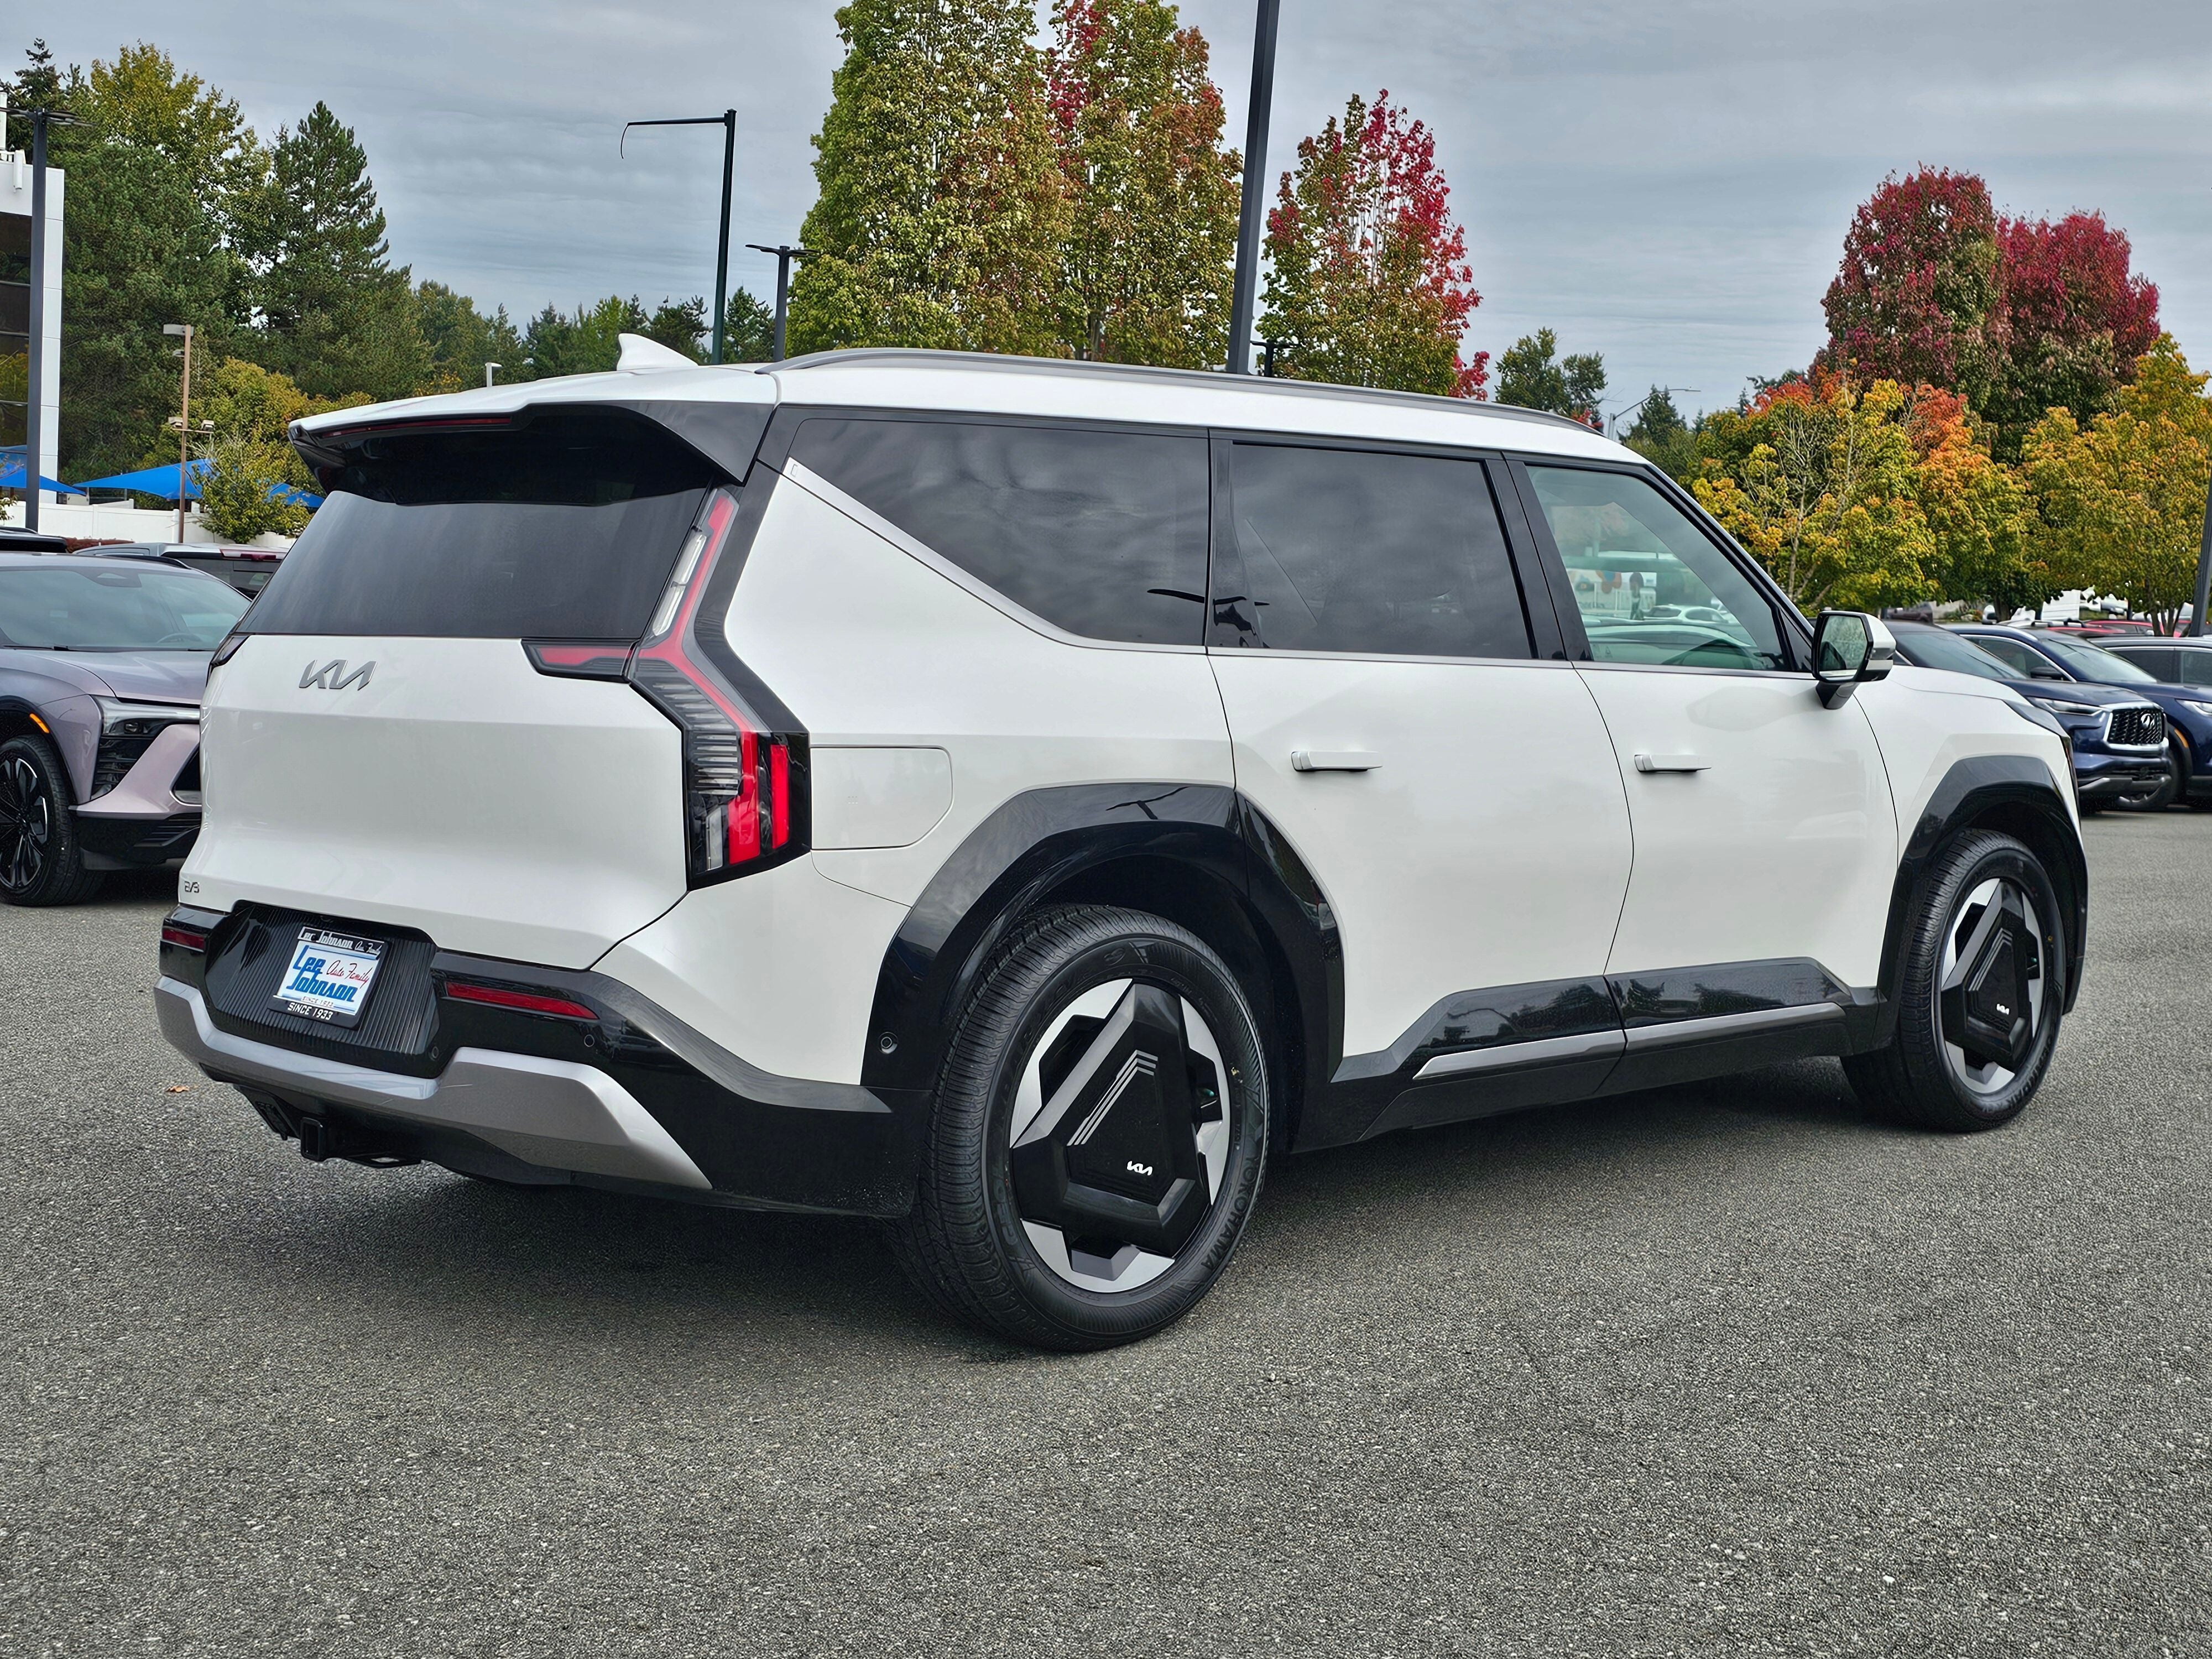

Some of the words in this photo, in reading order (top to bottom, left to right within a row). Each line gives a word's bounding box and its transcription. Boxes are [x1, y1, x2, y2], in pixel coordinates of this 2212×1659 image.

[299, 659, 377, 691] KIA
[316, 930, 354, 950] Johnson
[293, 945, 326, 974] Lee
[286, 969, 358, 1002] Johnson
[345, 963, 373, 989] Family
[288, 1002, 312, 1015] SINCE
[312, 1008, 333, 1020] 1933
[1127, 1161, 1153, 1176] KIA
[1201, 1149, 1260, 1270] YOKOHAMA
